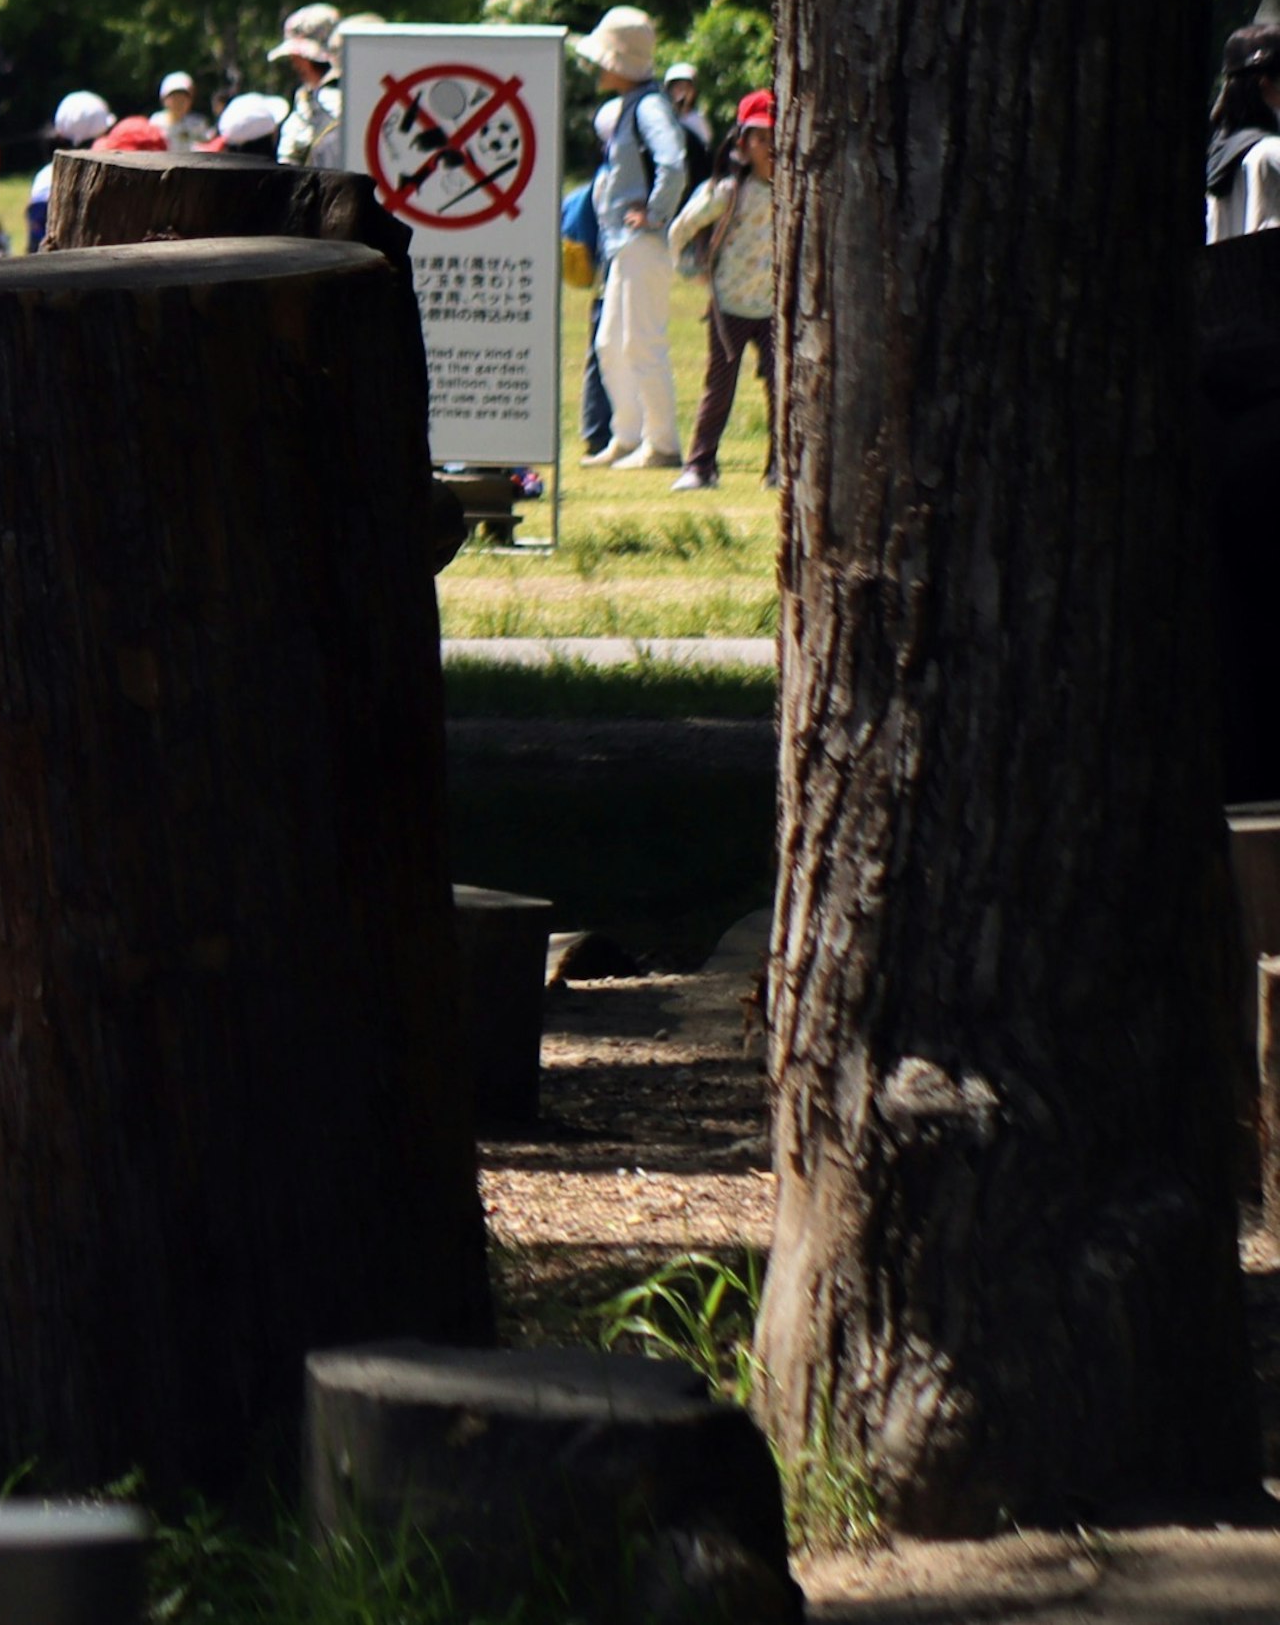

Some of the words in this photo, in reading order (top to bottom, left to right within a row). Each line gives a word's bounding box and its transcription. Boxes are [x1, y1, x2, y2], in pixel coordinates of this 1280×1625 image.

[457, 348, 480, 360] any
[485, 347, 512, 359] kind
[516, 347, 530, 359] of
[448, 362, 470, 373] the
[497, 379, 530, 390] soap
[482, 393, 510, 404] pets
[515, 394, 529, 404] or
[430, 407, 471, 419] drinks
[475, 408, 497, 419] are
[501, 408, 529, 420] also
